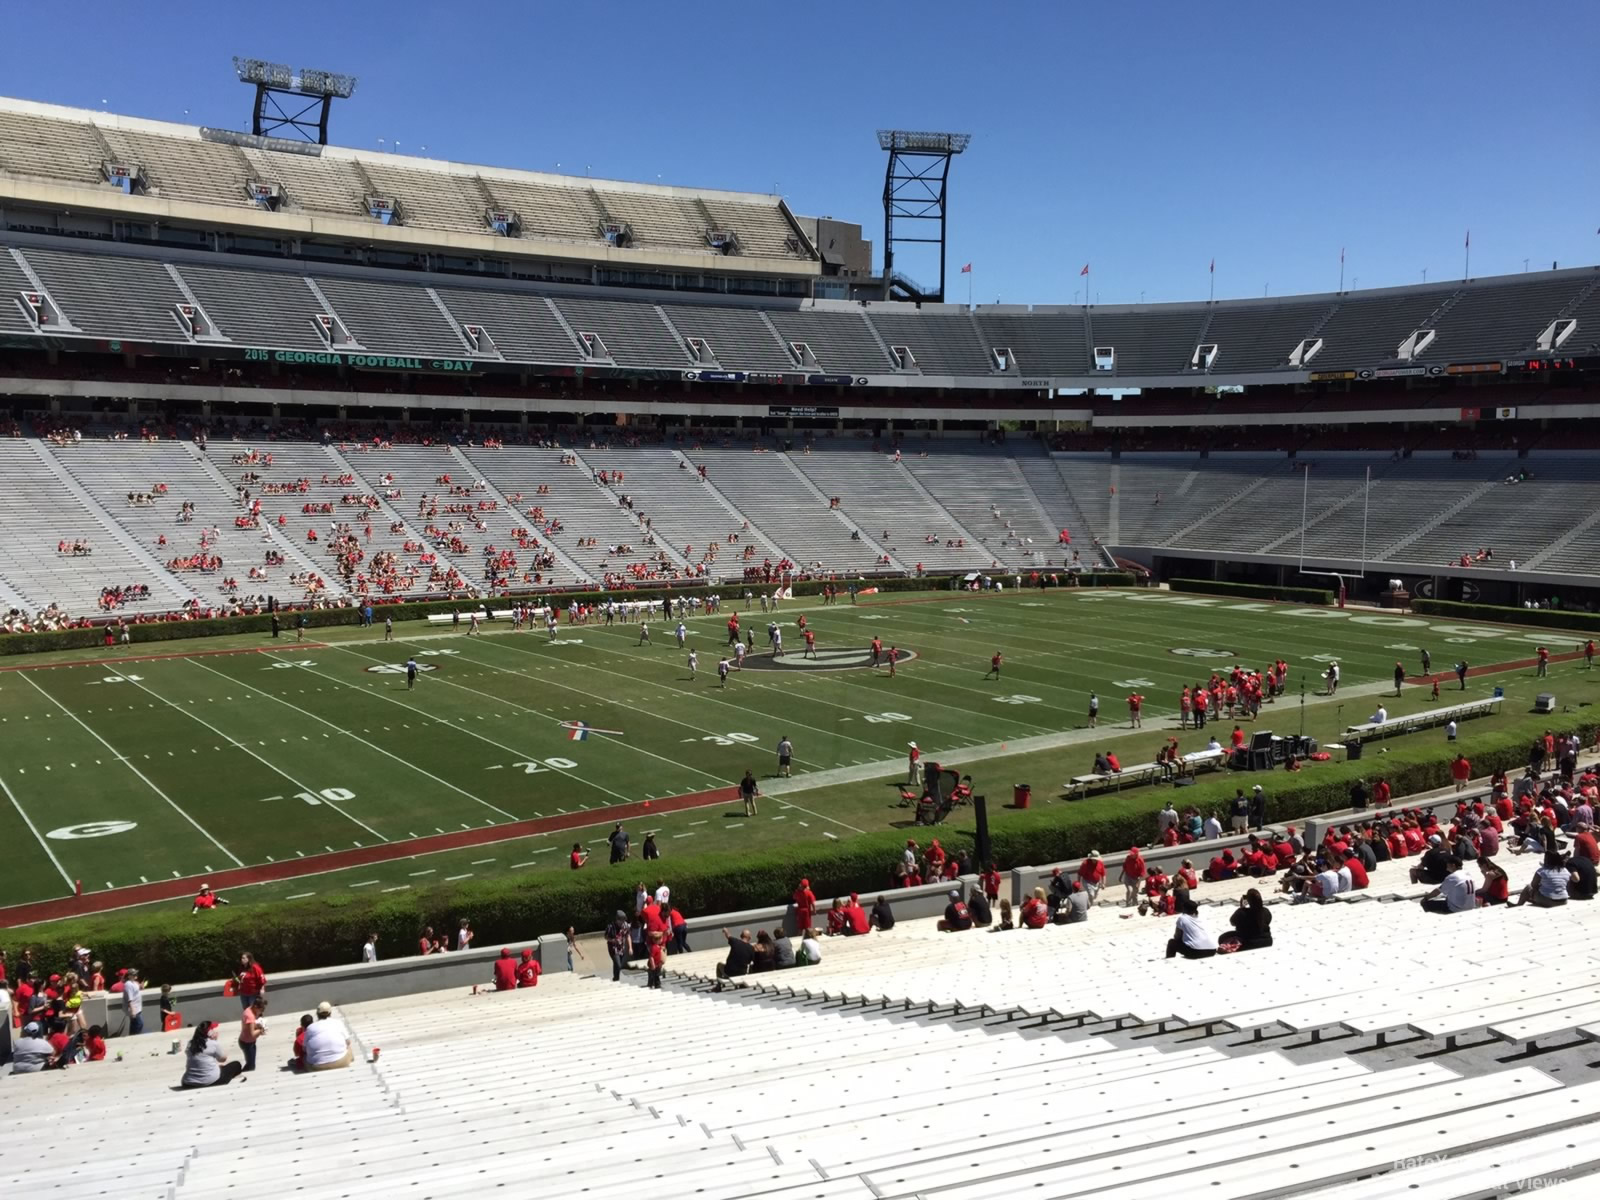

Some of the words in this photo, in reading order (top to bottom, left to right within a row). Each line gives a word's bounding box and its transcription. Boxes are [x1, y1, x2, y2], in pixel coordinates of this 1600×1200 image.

[245, 349, 269, 361] 2015
[274, 351, 342, 364] GEORGIA
[347, 355, 422, 369] FOOTBALL
[1528, 360, 1540, 369] 14
[863, 712, 913, 724] 40
[702, 732, 760, 746] 30
[512, 757, 579, 774] 20
[293, 787, 356, 806] 10
[45, 820, 138, 840] G
[1465, 879, 1475, 895] 11
[526, 968, 534, 980] 3
